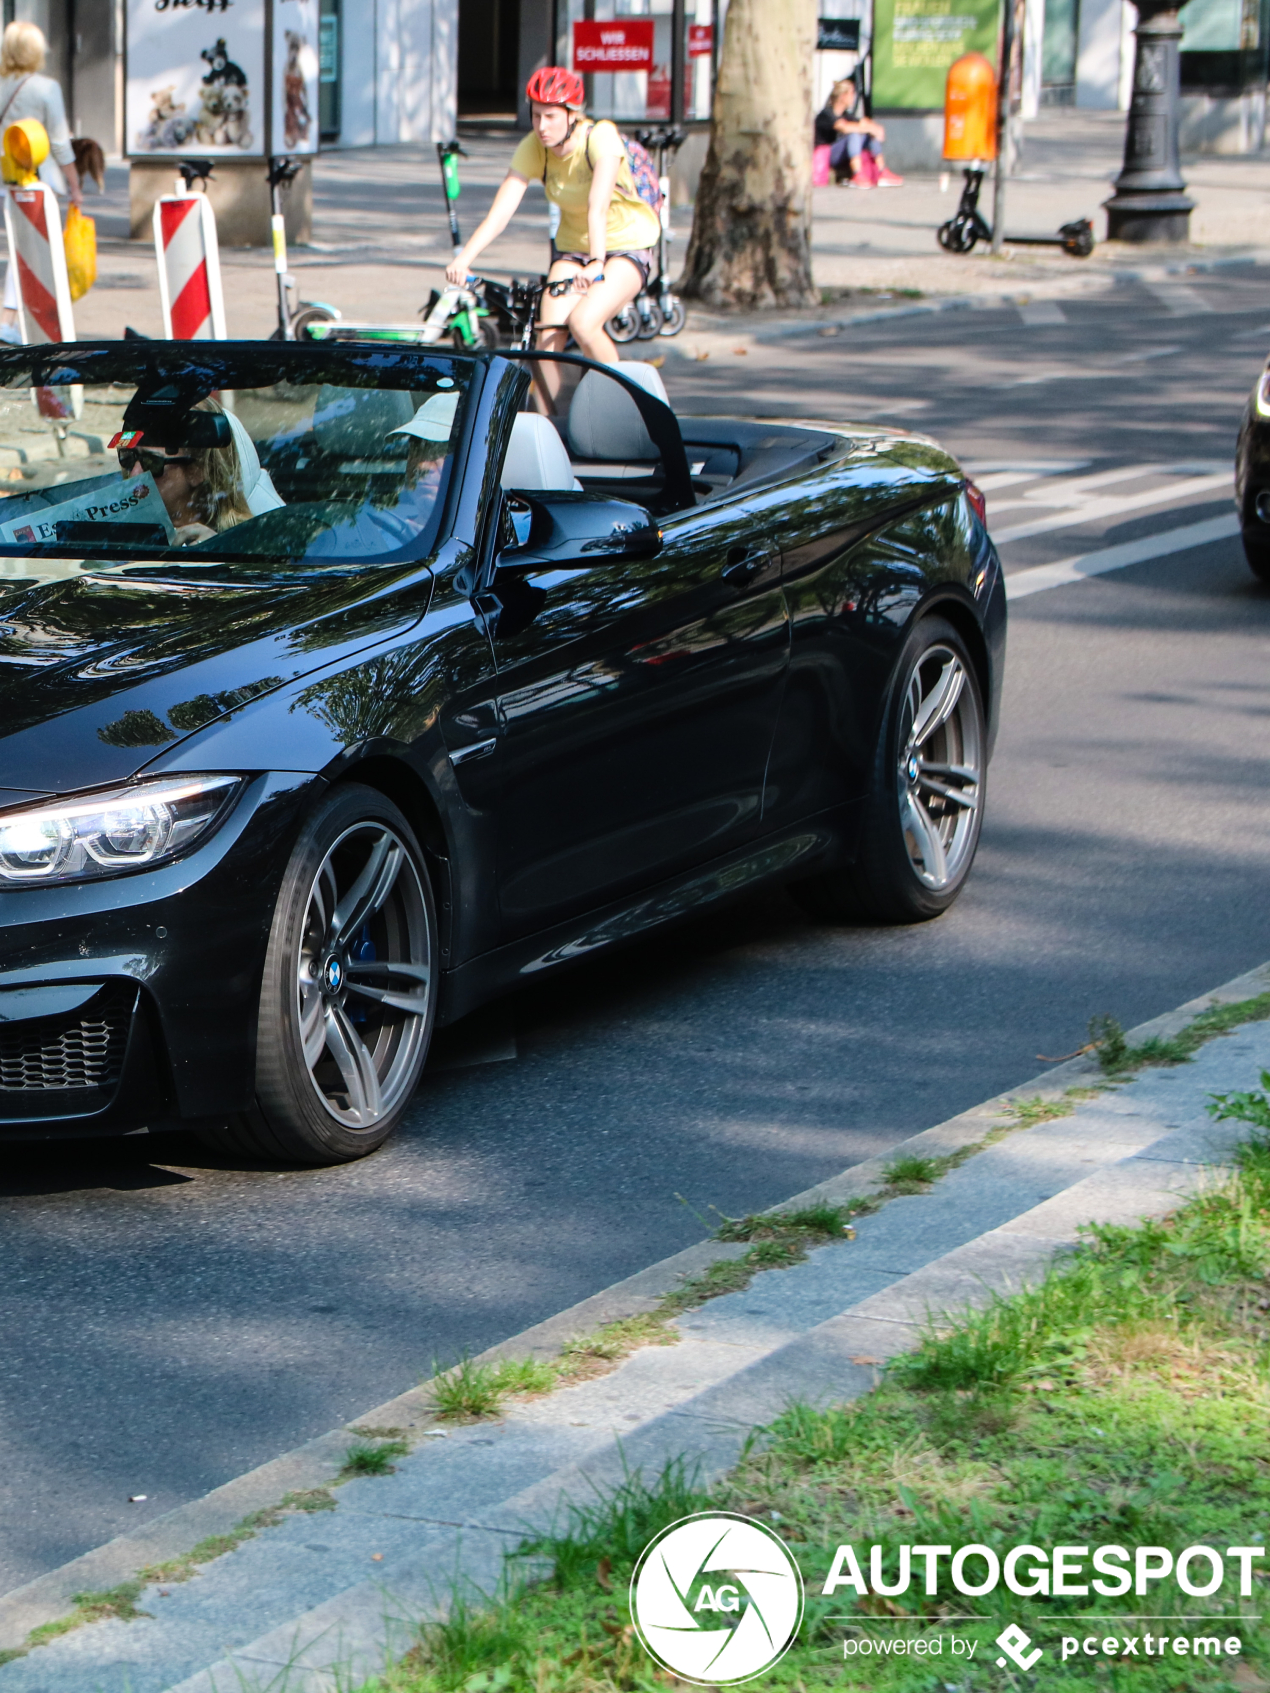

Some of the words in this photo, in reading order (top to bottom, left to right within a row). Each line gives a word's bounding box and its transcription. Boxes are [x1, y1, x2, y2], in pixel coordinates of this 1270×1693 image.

[600, 31, 626, 45] WIR
[576, 47, 649, 61] SCHLIESSEN
[85, 495, 139, 520] Press
